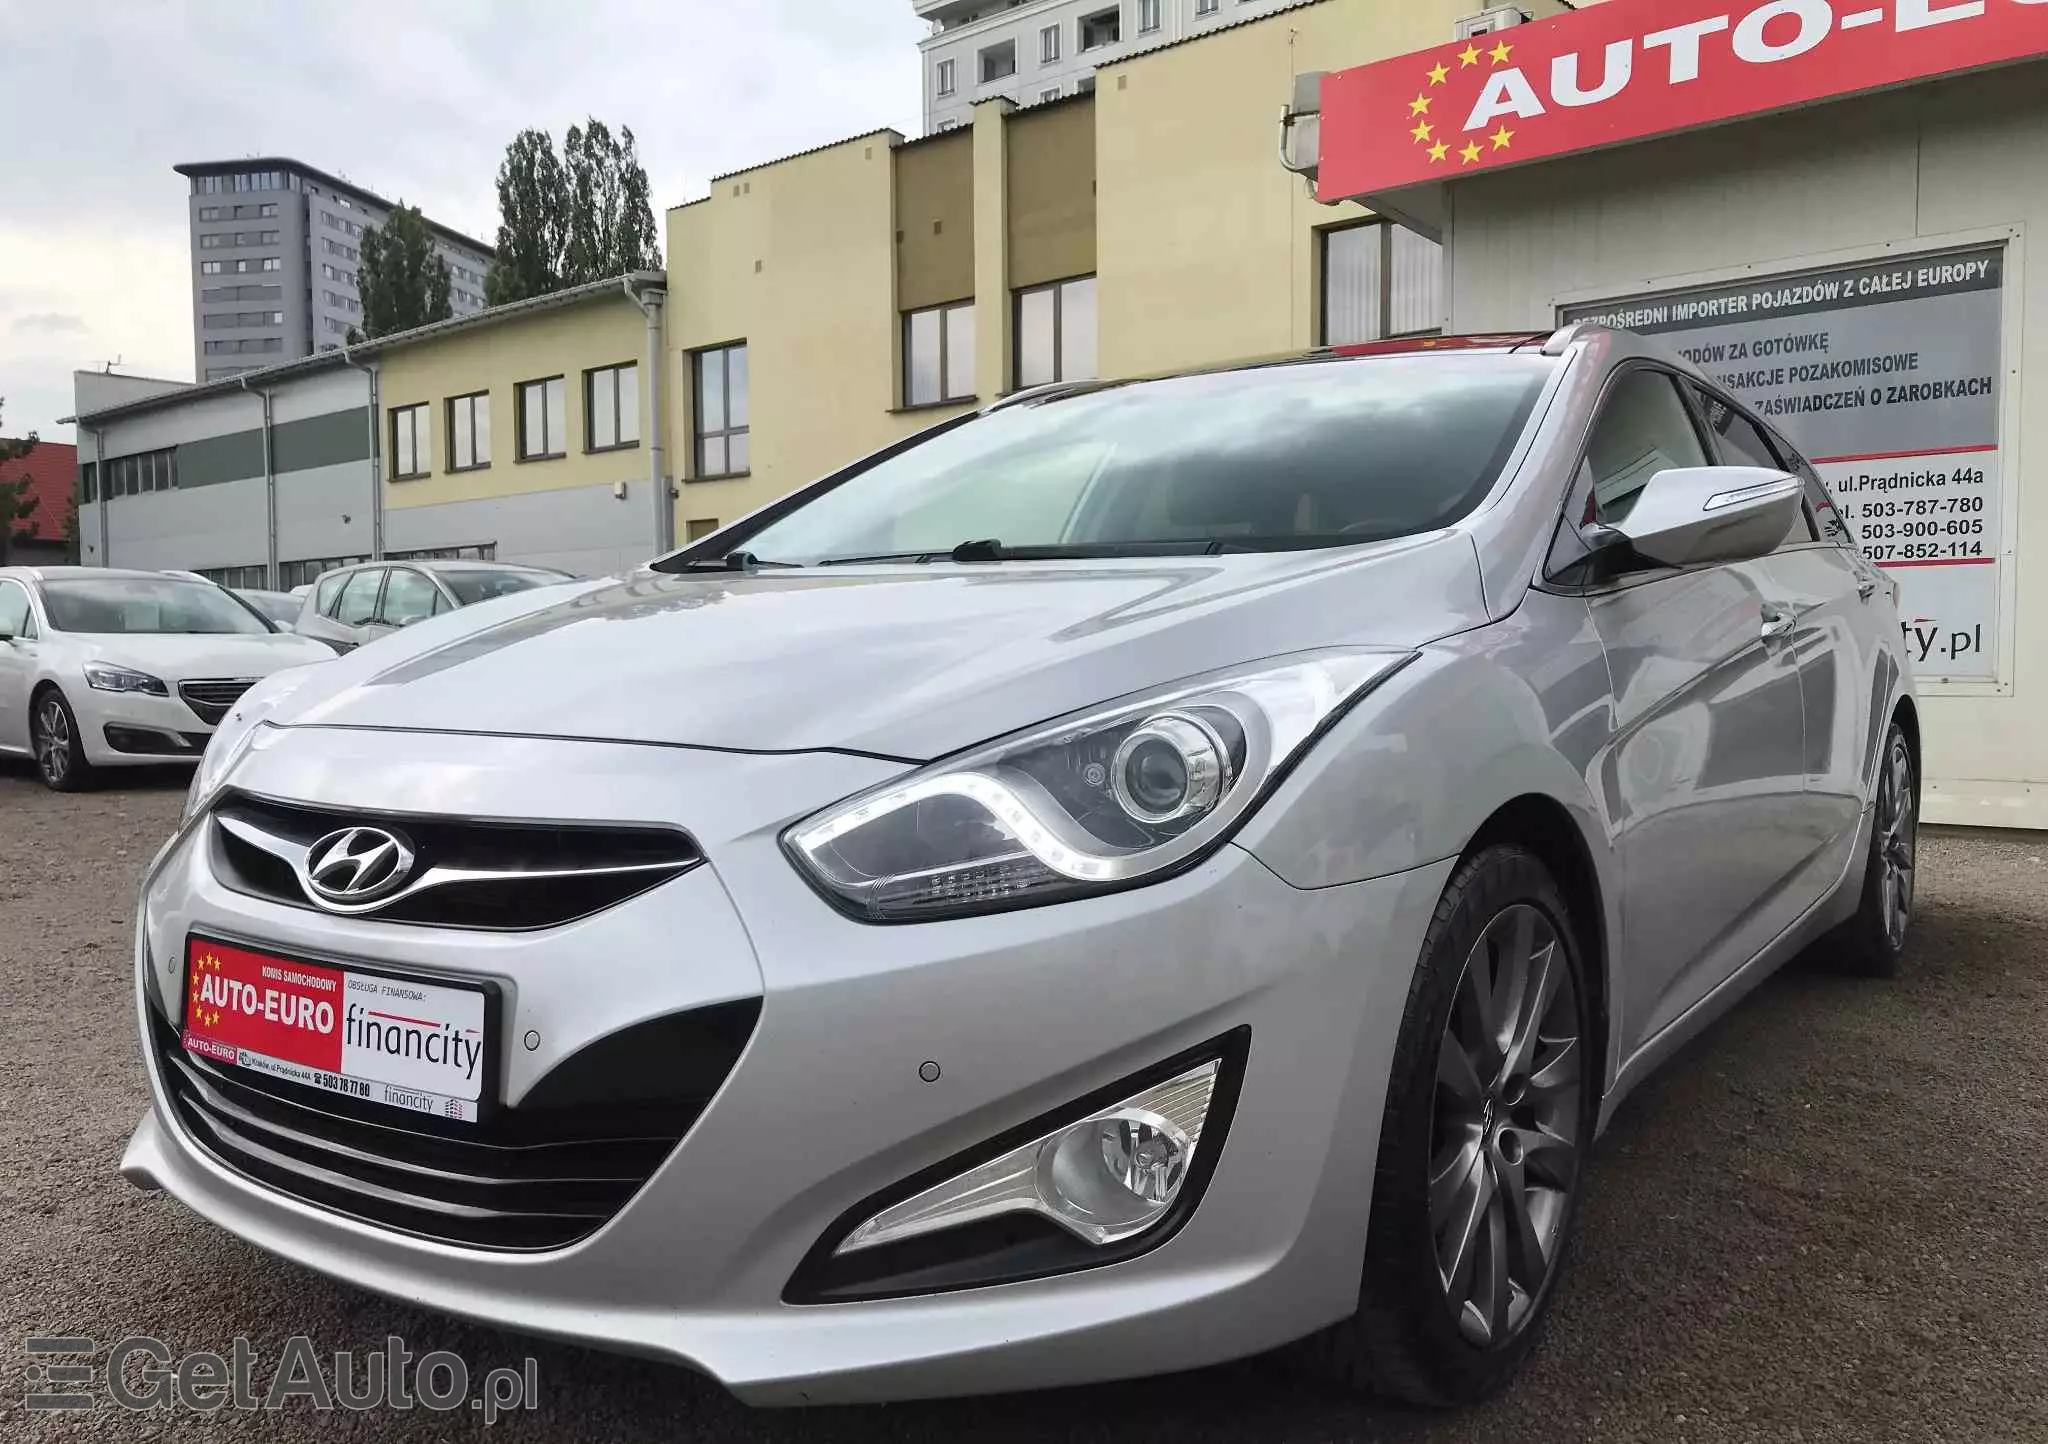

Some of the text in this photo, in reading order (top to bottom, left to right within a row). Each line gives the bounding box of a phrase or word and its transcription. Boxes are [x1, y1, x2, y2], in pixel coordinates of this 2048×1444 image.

[1672, 296, 1747, 321] IMPORTER
[1752, 280, 1839, 310] POJAZDÓW
[1844, 279, 1854, 297] Z
[1859, 270, 1912, 295] CAŁEJ
[1917, 259, 1989, 286] EUROPY
[1678, 332, 1829, 364] ODÓW ZA GOTÓWKĘ
[1789, 352, 1919, 383] POZAKOMISOWE
[1754, 386, 1865, 416] ZAŚWIADCZEŃ
[1871, 388, 1882, 406] O
[1886, 376, 1992, 404] ZAROBKACH
[1838, 470, 1946, 494] ul.Prądnicka
[1952, 467, 1984, 485] 44a
[1862, 496, 1983, 518] 503-787-780
[1861, 519, 1983, 540] 503-900-605
[1862, 541, 1983, 560] 507-852-114
[262, 965, 337, 993] KOMIS SAMOCHODOWY
[200, 973, 335, 1034] AUTO-EURO
[187, 1037, 235, 1060] AUTO-EURO
[346, 1003, 482, 1080] financity
[323, 1075, 338, 1091] 503
[384, 1085, 434, 1112] financity
